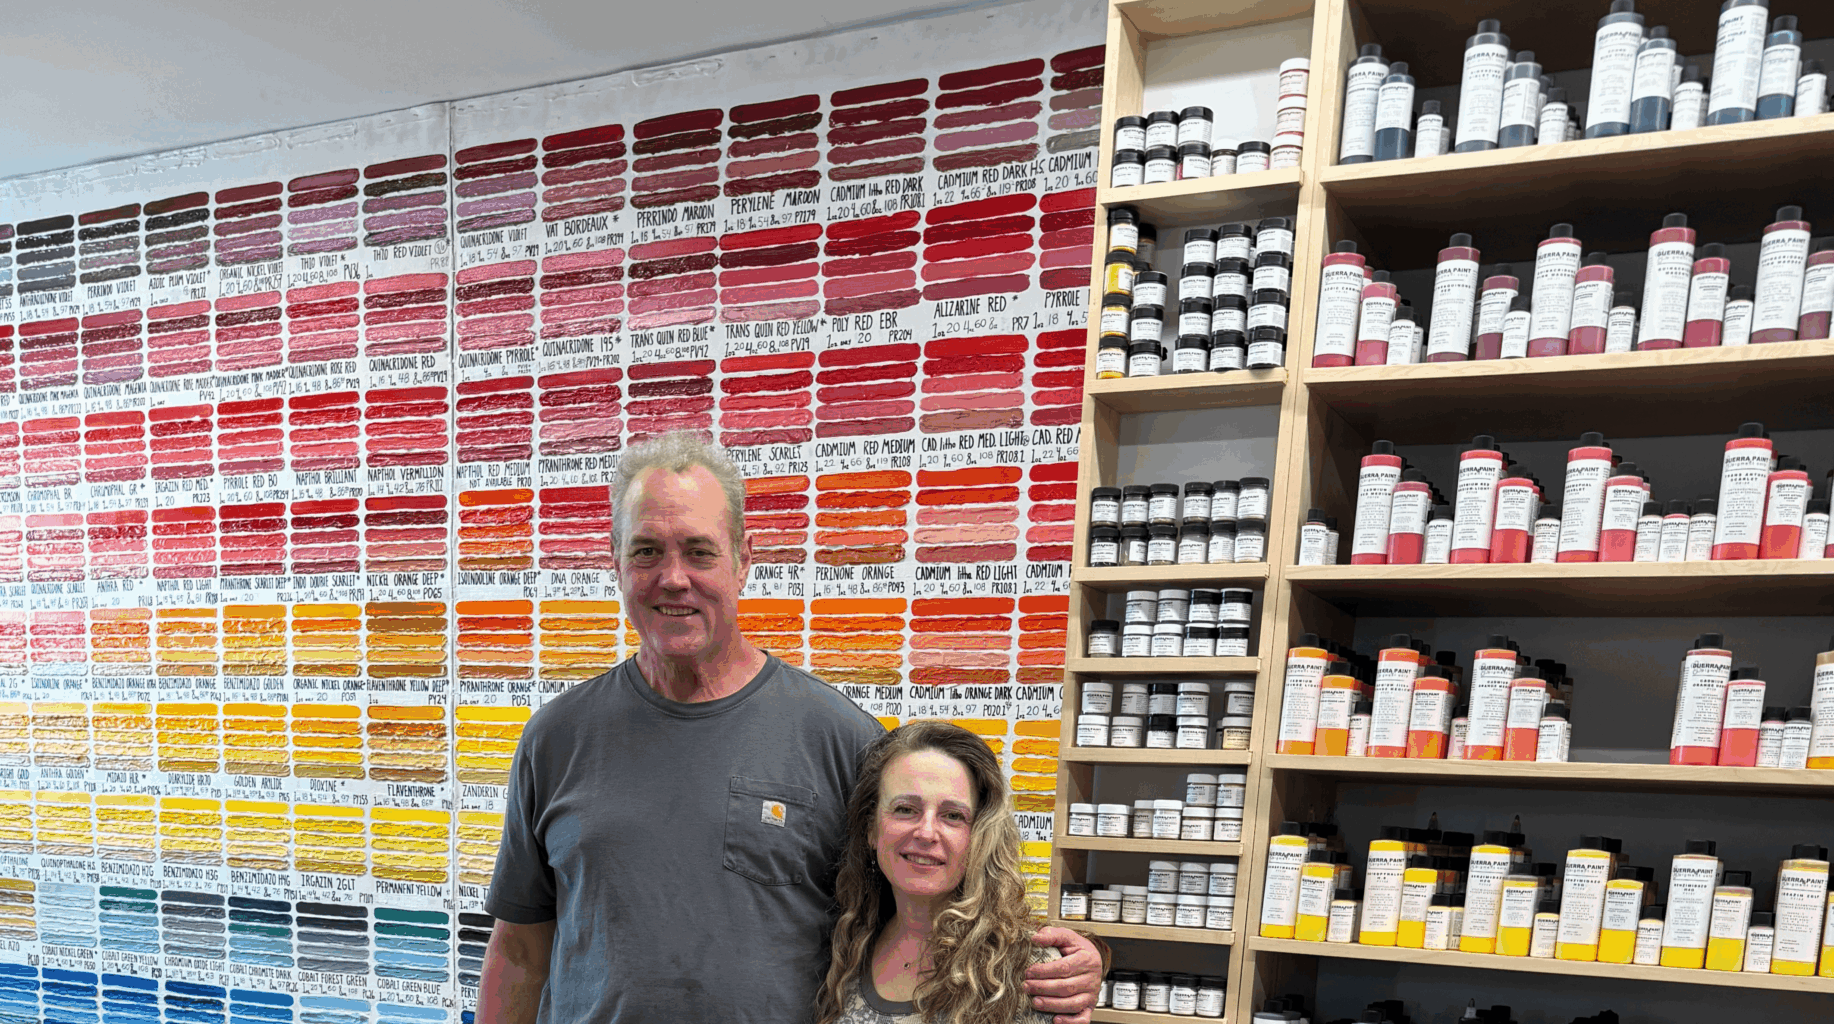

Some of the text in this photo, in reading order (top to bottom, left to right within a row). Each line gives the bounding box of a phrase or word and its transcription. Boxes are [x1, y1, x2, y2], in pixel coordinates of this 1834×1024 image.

[1048, 152, 1091, 172] CADMIUM
[938, 164, 1027, 190] CADMIUM RED DARK
[831, 176, 923, 202] CADMIUM RED DARK
[731, 189, 820, 215] PERYLENE MAROON
[637, 205, 714, 228] PERRINDO MAROON
[546, 219, 608, 238] VAT BORDEAUX
[373, 245, 432, 261] THIO RED VIOLET
[1044, 290, 1081, 308] PYRROLE
[934, 295, 1007, 319] ALIZARINE RED
[725, 316, 821, 339] TRANS QUIN RED YELLOW
[832, 311, 898, 332] POLY RED EBR
[631, 326, 709, 348] TRANS QUIN RED BLUE
[888, 329, 913, 342] PR204
[543, 337, 614, 357] QUINACRIDONE 195
[344, 361, 356, 373] RED
[421, 356, 435, 369] RED
[959, 434, 974, 450] RED
[1000, 430, 1024, 446] LIGHT
[1056, 428, 1073, 445] RED
[769, 445, 802, 461] SCARLET
[816, 438, 915, 458] CADMIUM RED MEDIUM
[488, 462, 530, 477] RED MEDIUM
[538, 458, 597, 473] PYRANTHRONE RED
[890, 455, 911, 469] PR108
[253, 476, 265, 488] RED
[368, 467, 444, 482] NAPTHOL VERMILLION
[367, 572, 438, 586] NICKEL ORANGE DEEP
[523, 572, 537, 584] DEEP
[551, 572, 600, 585] DNA ORANGE
[755, 566, 801, 581] ORANGE 4R
[815, 566, 894, 581] PERINONE ORANGE
[916, 564, 1017, 581] CADMIUM RED LIGHT
[1026, 564, 1063, 579] CADMIUM
[410, 680, 446, 692] YELLOW DEEP
[460, 681, 532, 693] PYRANTHRONE ORANGE
[842, 686, 903, 700] ORANGE MEDIUM
[910, 686, 1013, 701] CADMIUM ORANGE DARK
[1016, 686, 1055, 701] CADMIUM
[387, 784, 435, 798] FLAVENTHRONE
[463, 785, 499, 798] ZANDERIN
[301, 875, 333, 888] IRGAZIN
[376, 881, 442, 897] PERMANENT YELLOW
[321, 973, 367, 986] FOREST GREEN
[402, 981, 421, 993] GREEN
[424, 983, 440, 995] BLUE
